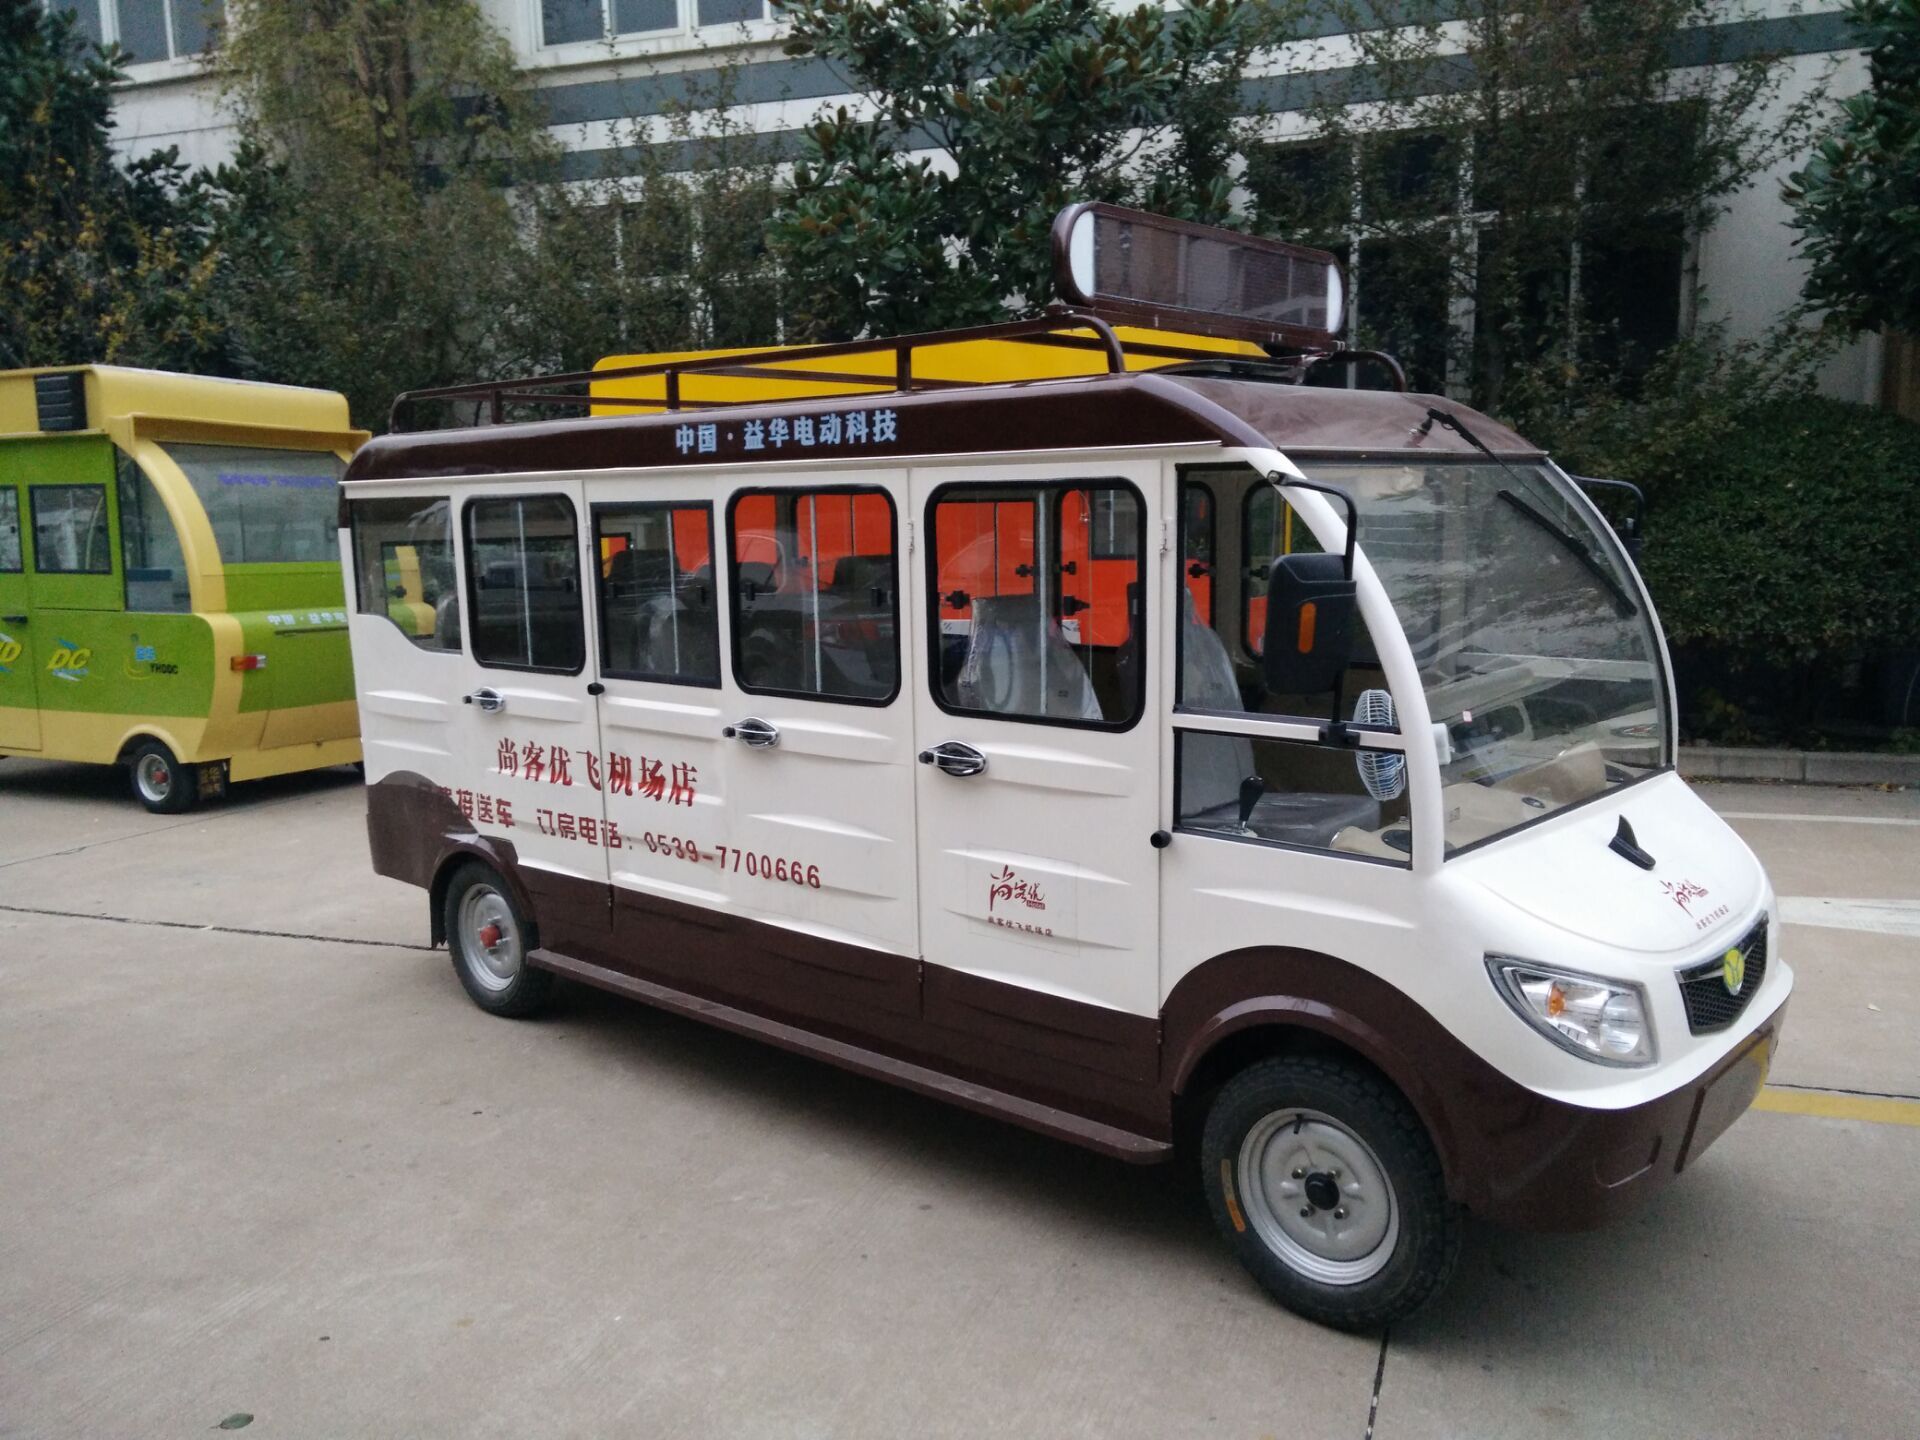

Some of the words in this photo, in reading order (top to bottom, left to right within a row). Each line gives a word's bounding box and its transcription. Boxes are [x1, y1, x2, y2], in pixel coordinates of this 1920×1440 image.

[675, 409, 897, 454] 中国·益华电动科技
[46, 647, 92, 669] DC
[496, 737, 699, 808] 尚客优飞机场店
